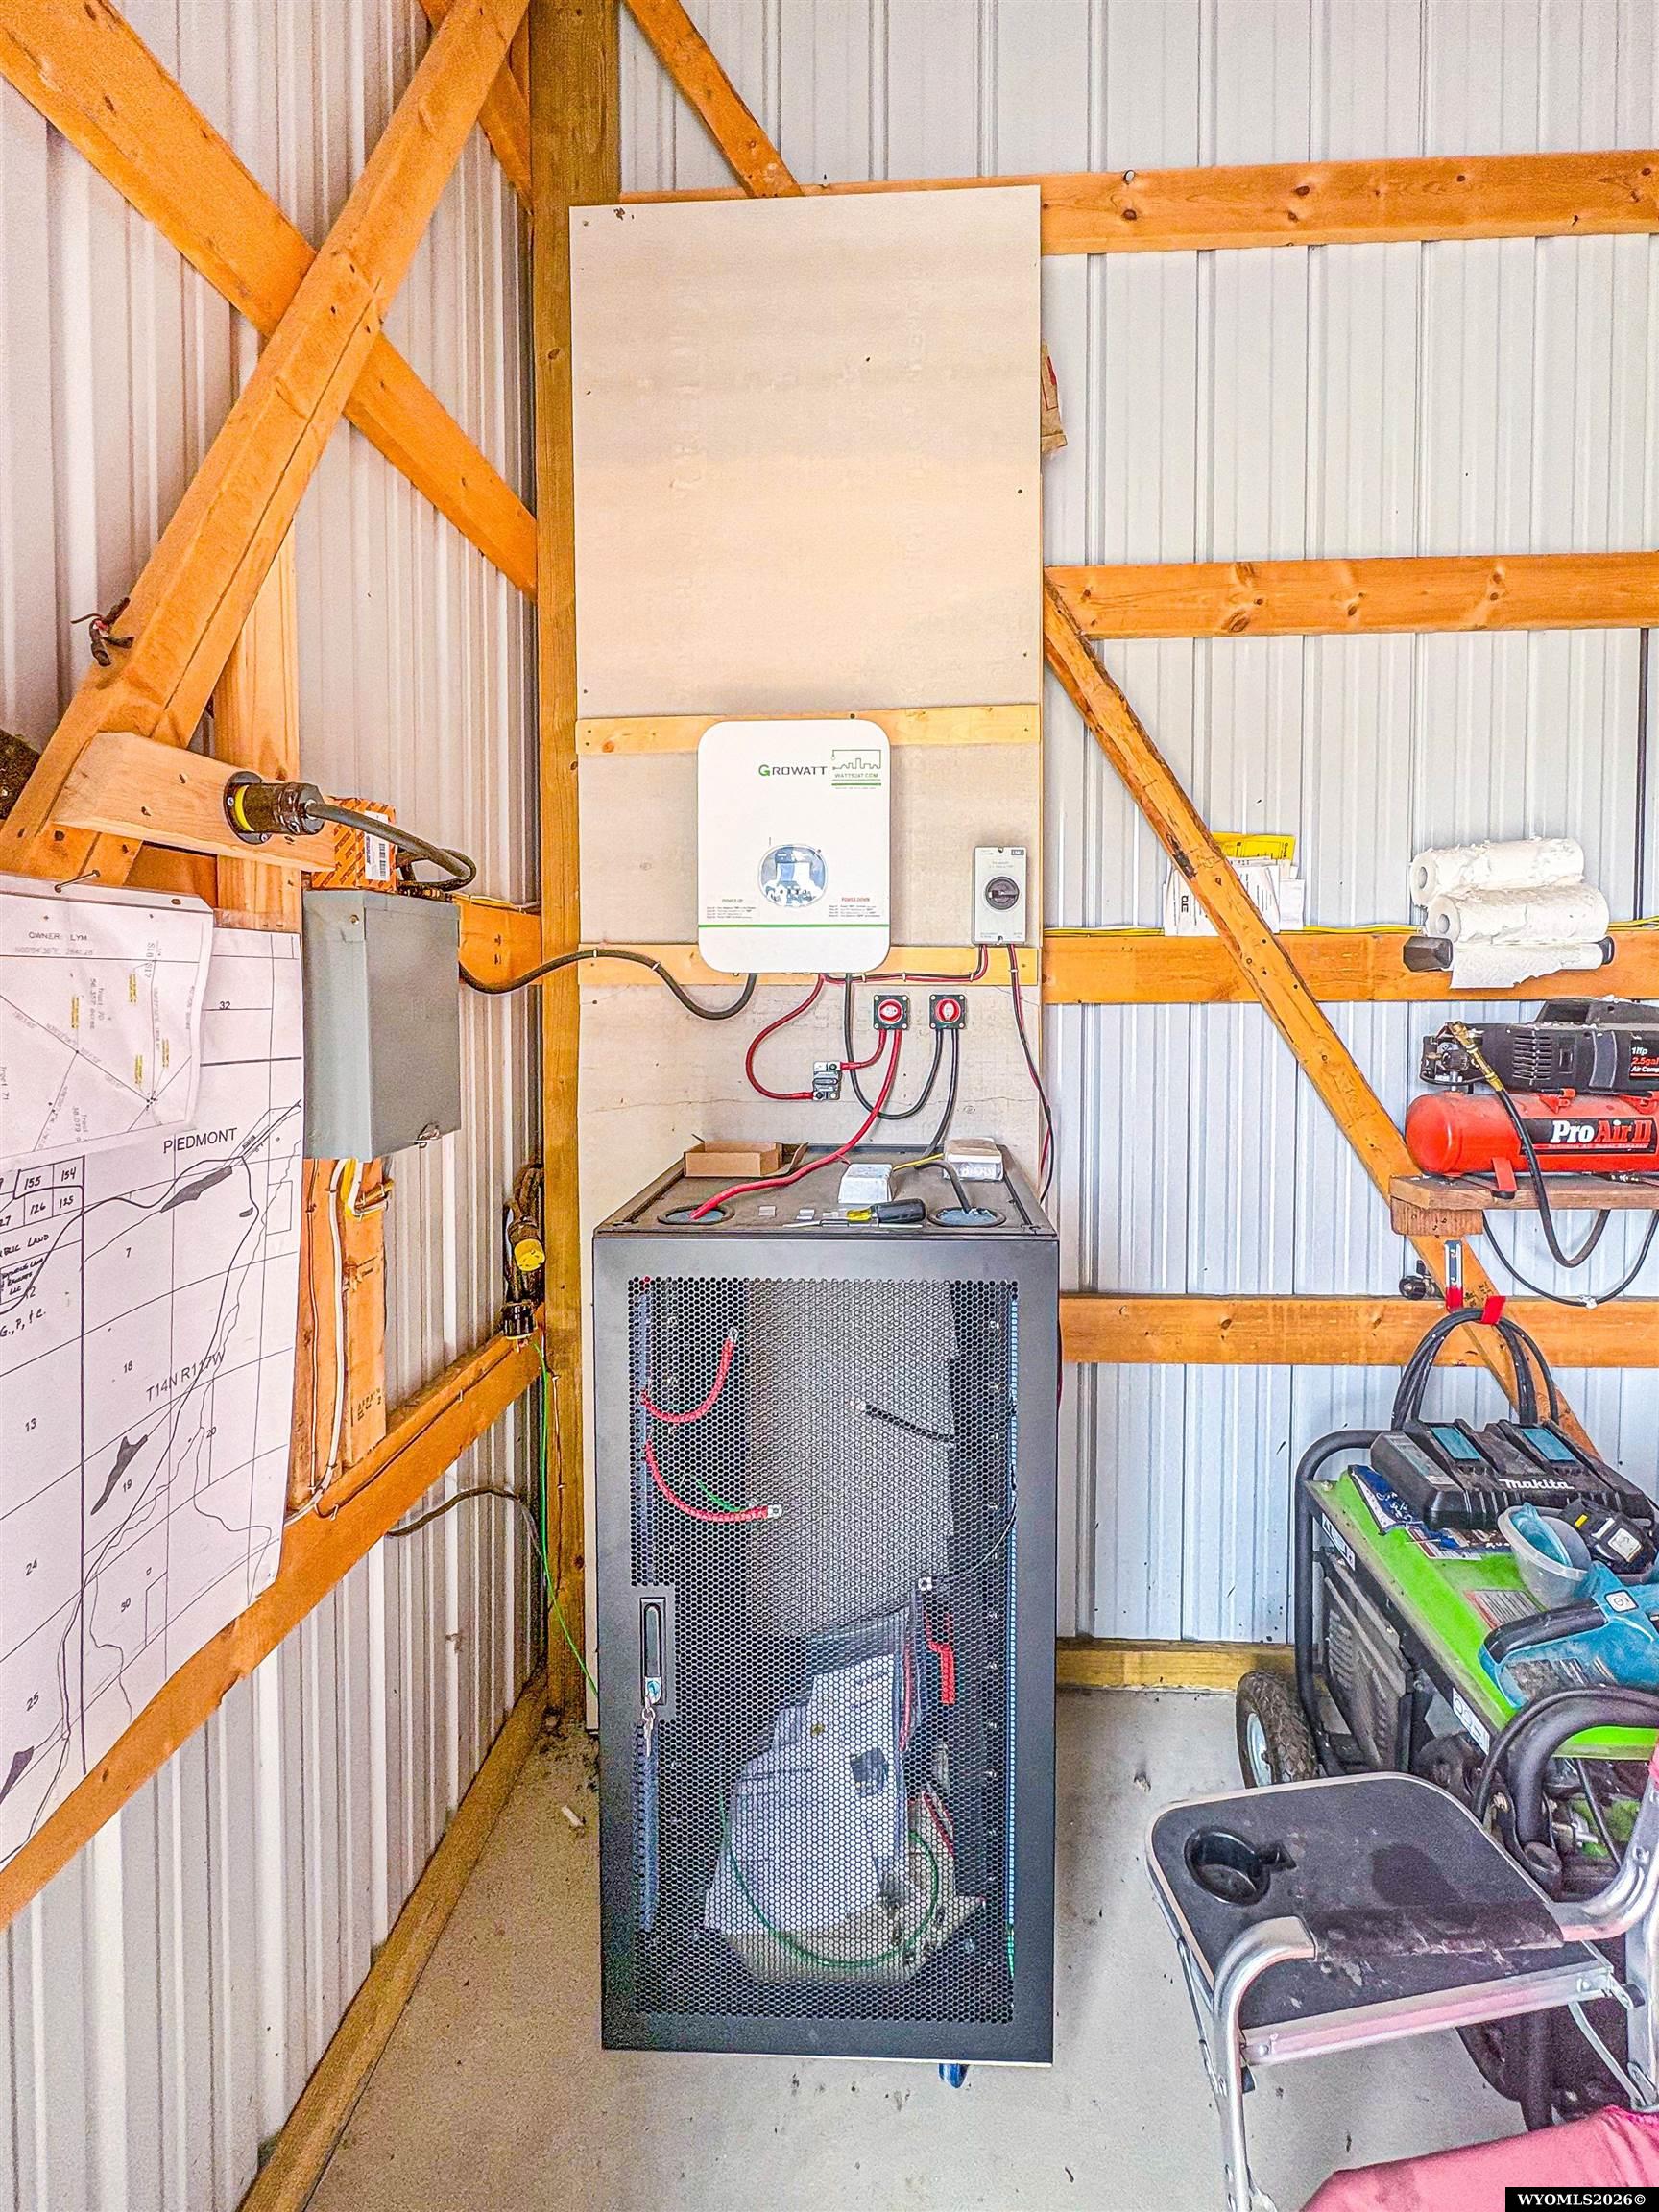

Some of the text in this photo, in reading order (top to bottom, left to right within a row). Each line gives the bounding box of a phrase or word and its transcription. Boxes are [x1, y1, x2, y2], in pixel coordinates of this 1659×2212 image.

[758, 764, 828, 776] GROWATT
[219, 1001, 231, 1010] 32
[1632, 1119, 1653, 1142] II
[162, 1127, 238, 1154] PIEDMONT
[61, 1167, 76, 1182] 154
[24, 1175, 41, 1190] 155
[30, 1201, 46, 1215] 126
[60, 1195, 74, 1208] 125
[0, 1215, 12, 1227] 27
[28, 1234, 49, 1246] LAND
[125, 1247, 132, 1258] 7
[123, 1360, 133, 1374] 18
[146, 1372, 179, 1402] T14N
[25, 1418, 36, 1432] 13
[123, 1479, 132, 1492] 19
[25, 1559, 38, 1576] 24
[26, 1692, 39, 1711] 25
